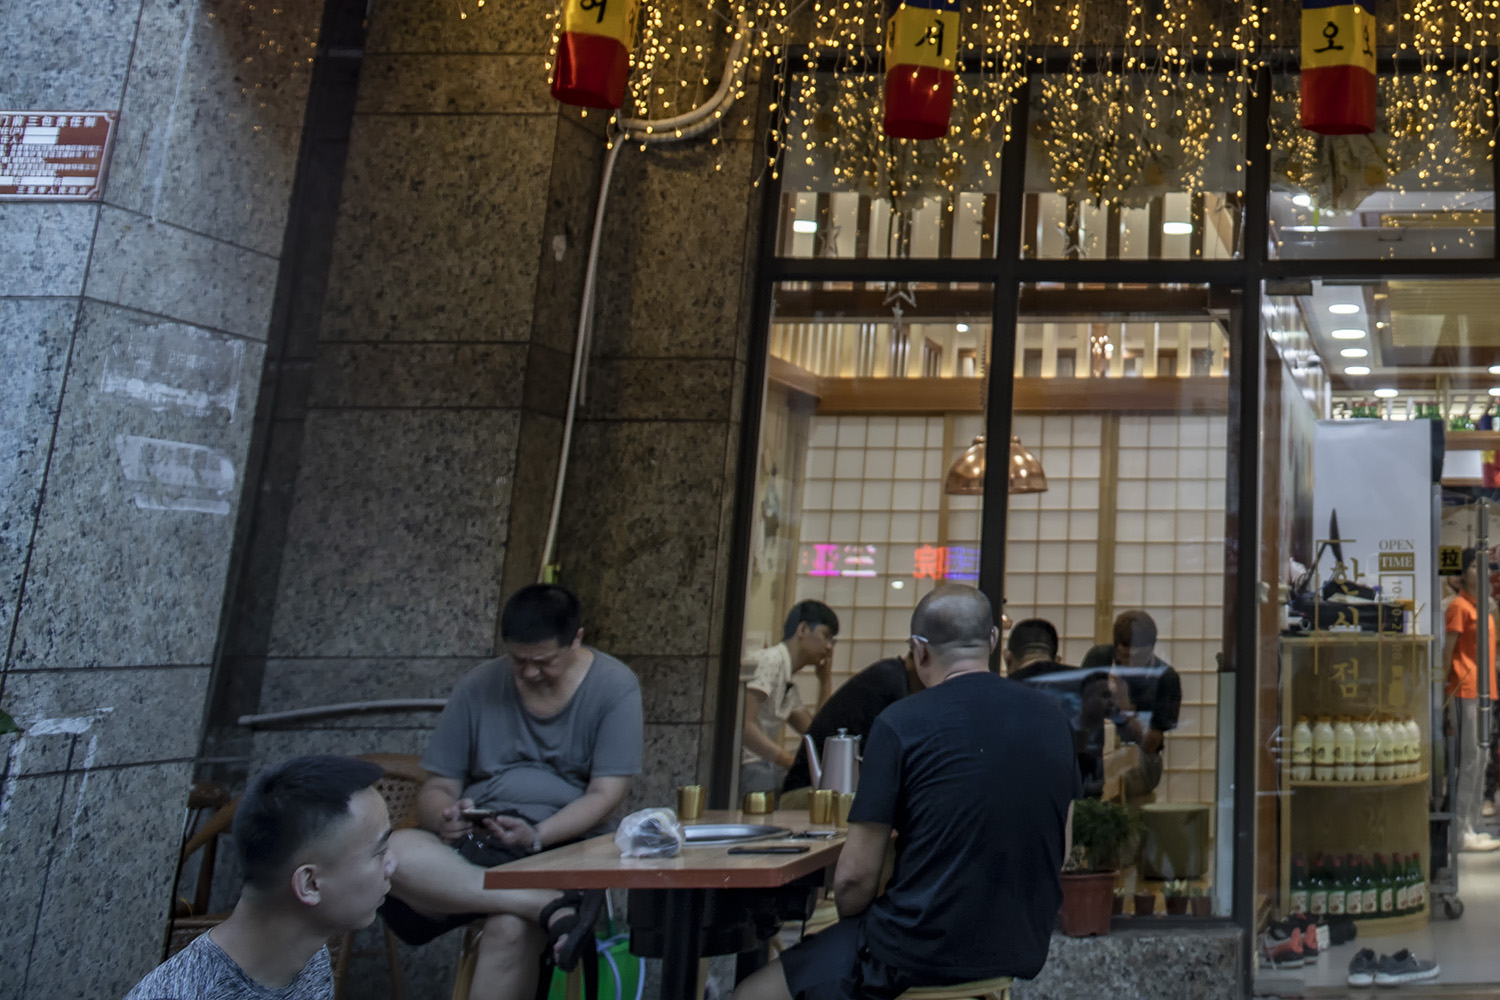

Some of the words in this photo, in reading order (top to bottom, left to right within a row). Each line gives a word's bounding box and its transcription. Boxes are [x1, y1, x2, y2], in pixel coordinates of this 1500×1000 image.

[1313, 20, 1345, 54] 오
[1379, 539, 1415, 551] OPEN
[1381, 556, 1413, 568] TIME
[1440, 548, 1460, 568] 拉
